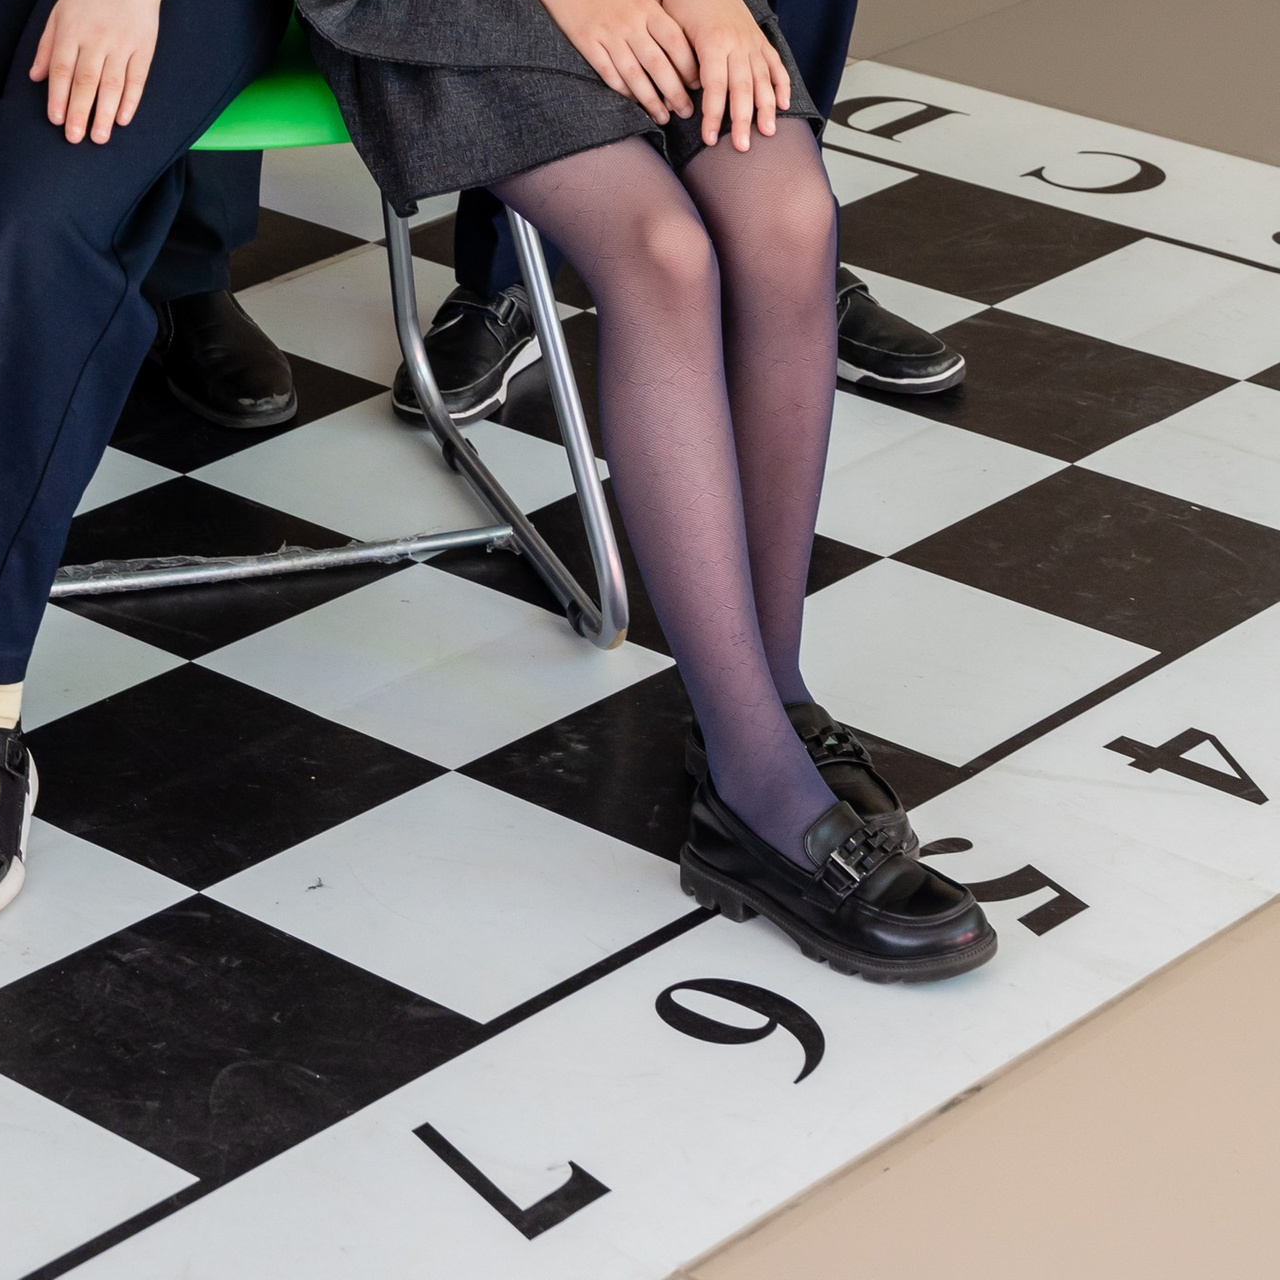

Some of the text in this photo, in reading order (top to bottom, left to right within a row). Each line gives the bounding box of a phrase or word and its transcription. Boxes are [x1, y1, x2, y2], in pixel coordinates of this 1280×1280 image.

[828, 95, 1167, 195] D C
[1102, 726, 1270, 806] 4
[411, 1121, 612, 1241] 7
